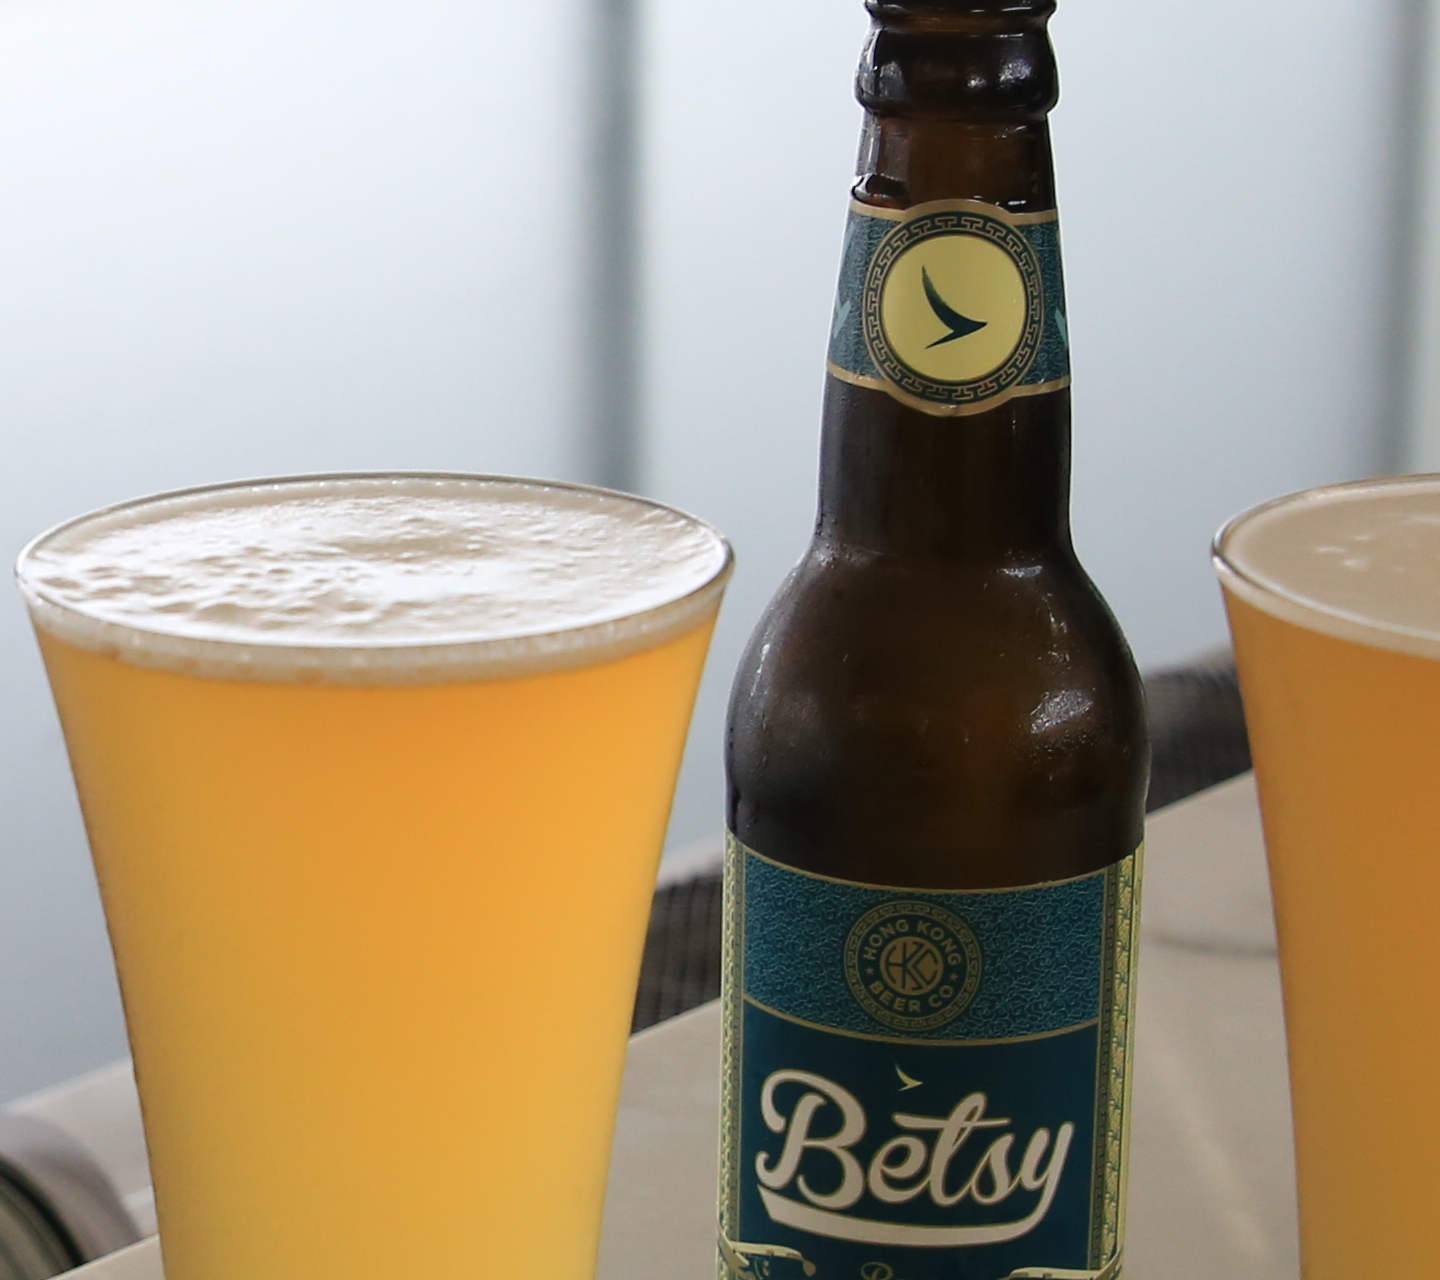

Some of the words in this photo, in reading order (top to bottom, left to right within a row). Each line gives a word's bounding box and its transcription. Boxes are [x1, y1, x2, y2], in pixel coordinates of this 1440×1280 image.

[862, 918, 910, 961] HONG
[916, 920, 963, 966] KONG
[869, 980, 922, 1012] BEER
[928, 984, 955, 1008] CO
[753, 1067, 1075, 1248] Betsy
